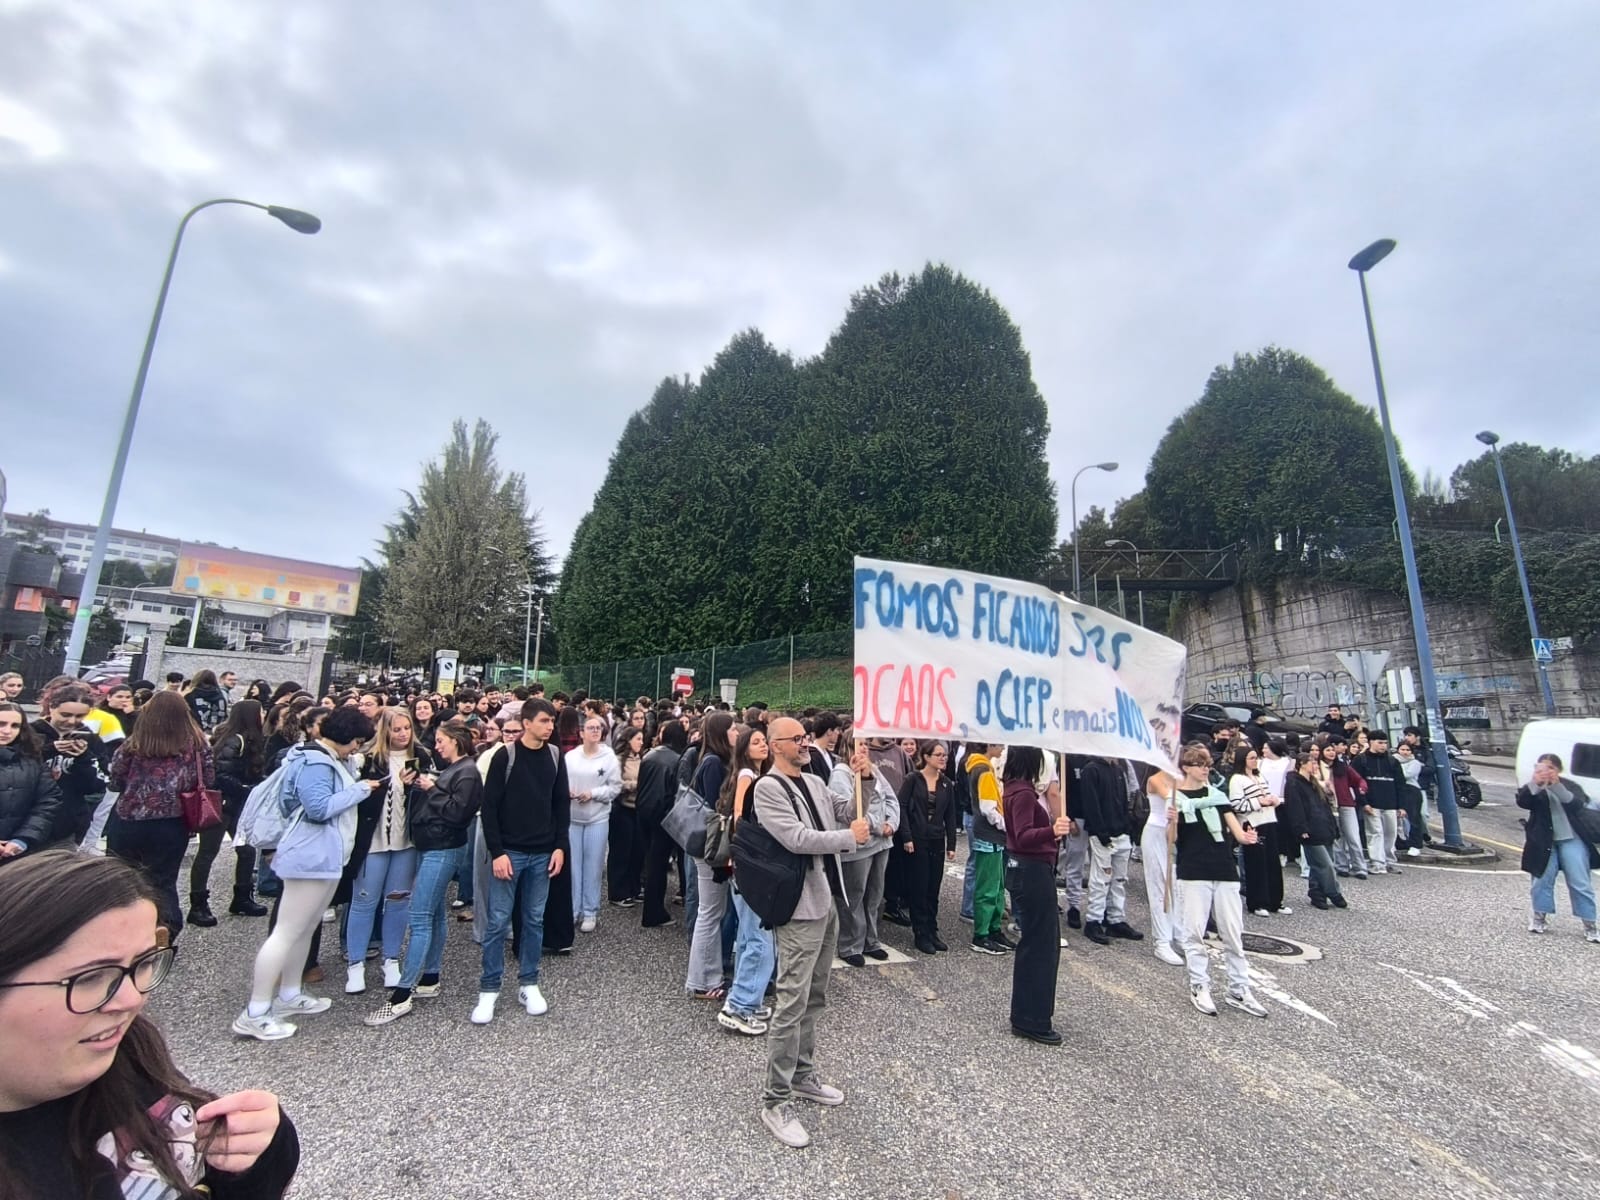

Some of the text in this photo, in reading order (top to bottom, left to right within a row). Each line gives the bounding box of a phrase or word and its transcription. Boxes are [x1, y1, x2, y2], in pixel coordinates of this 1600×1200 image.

[855, 568, 963, 638] FOMOS
[972, 582, 1060, 657] FICANDO
[1063, 707, 1117, 733] mais
